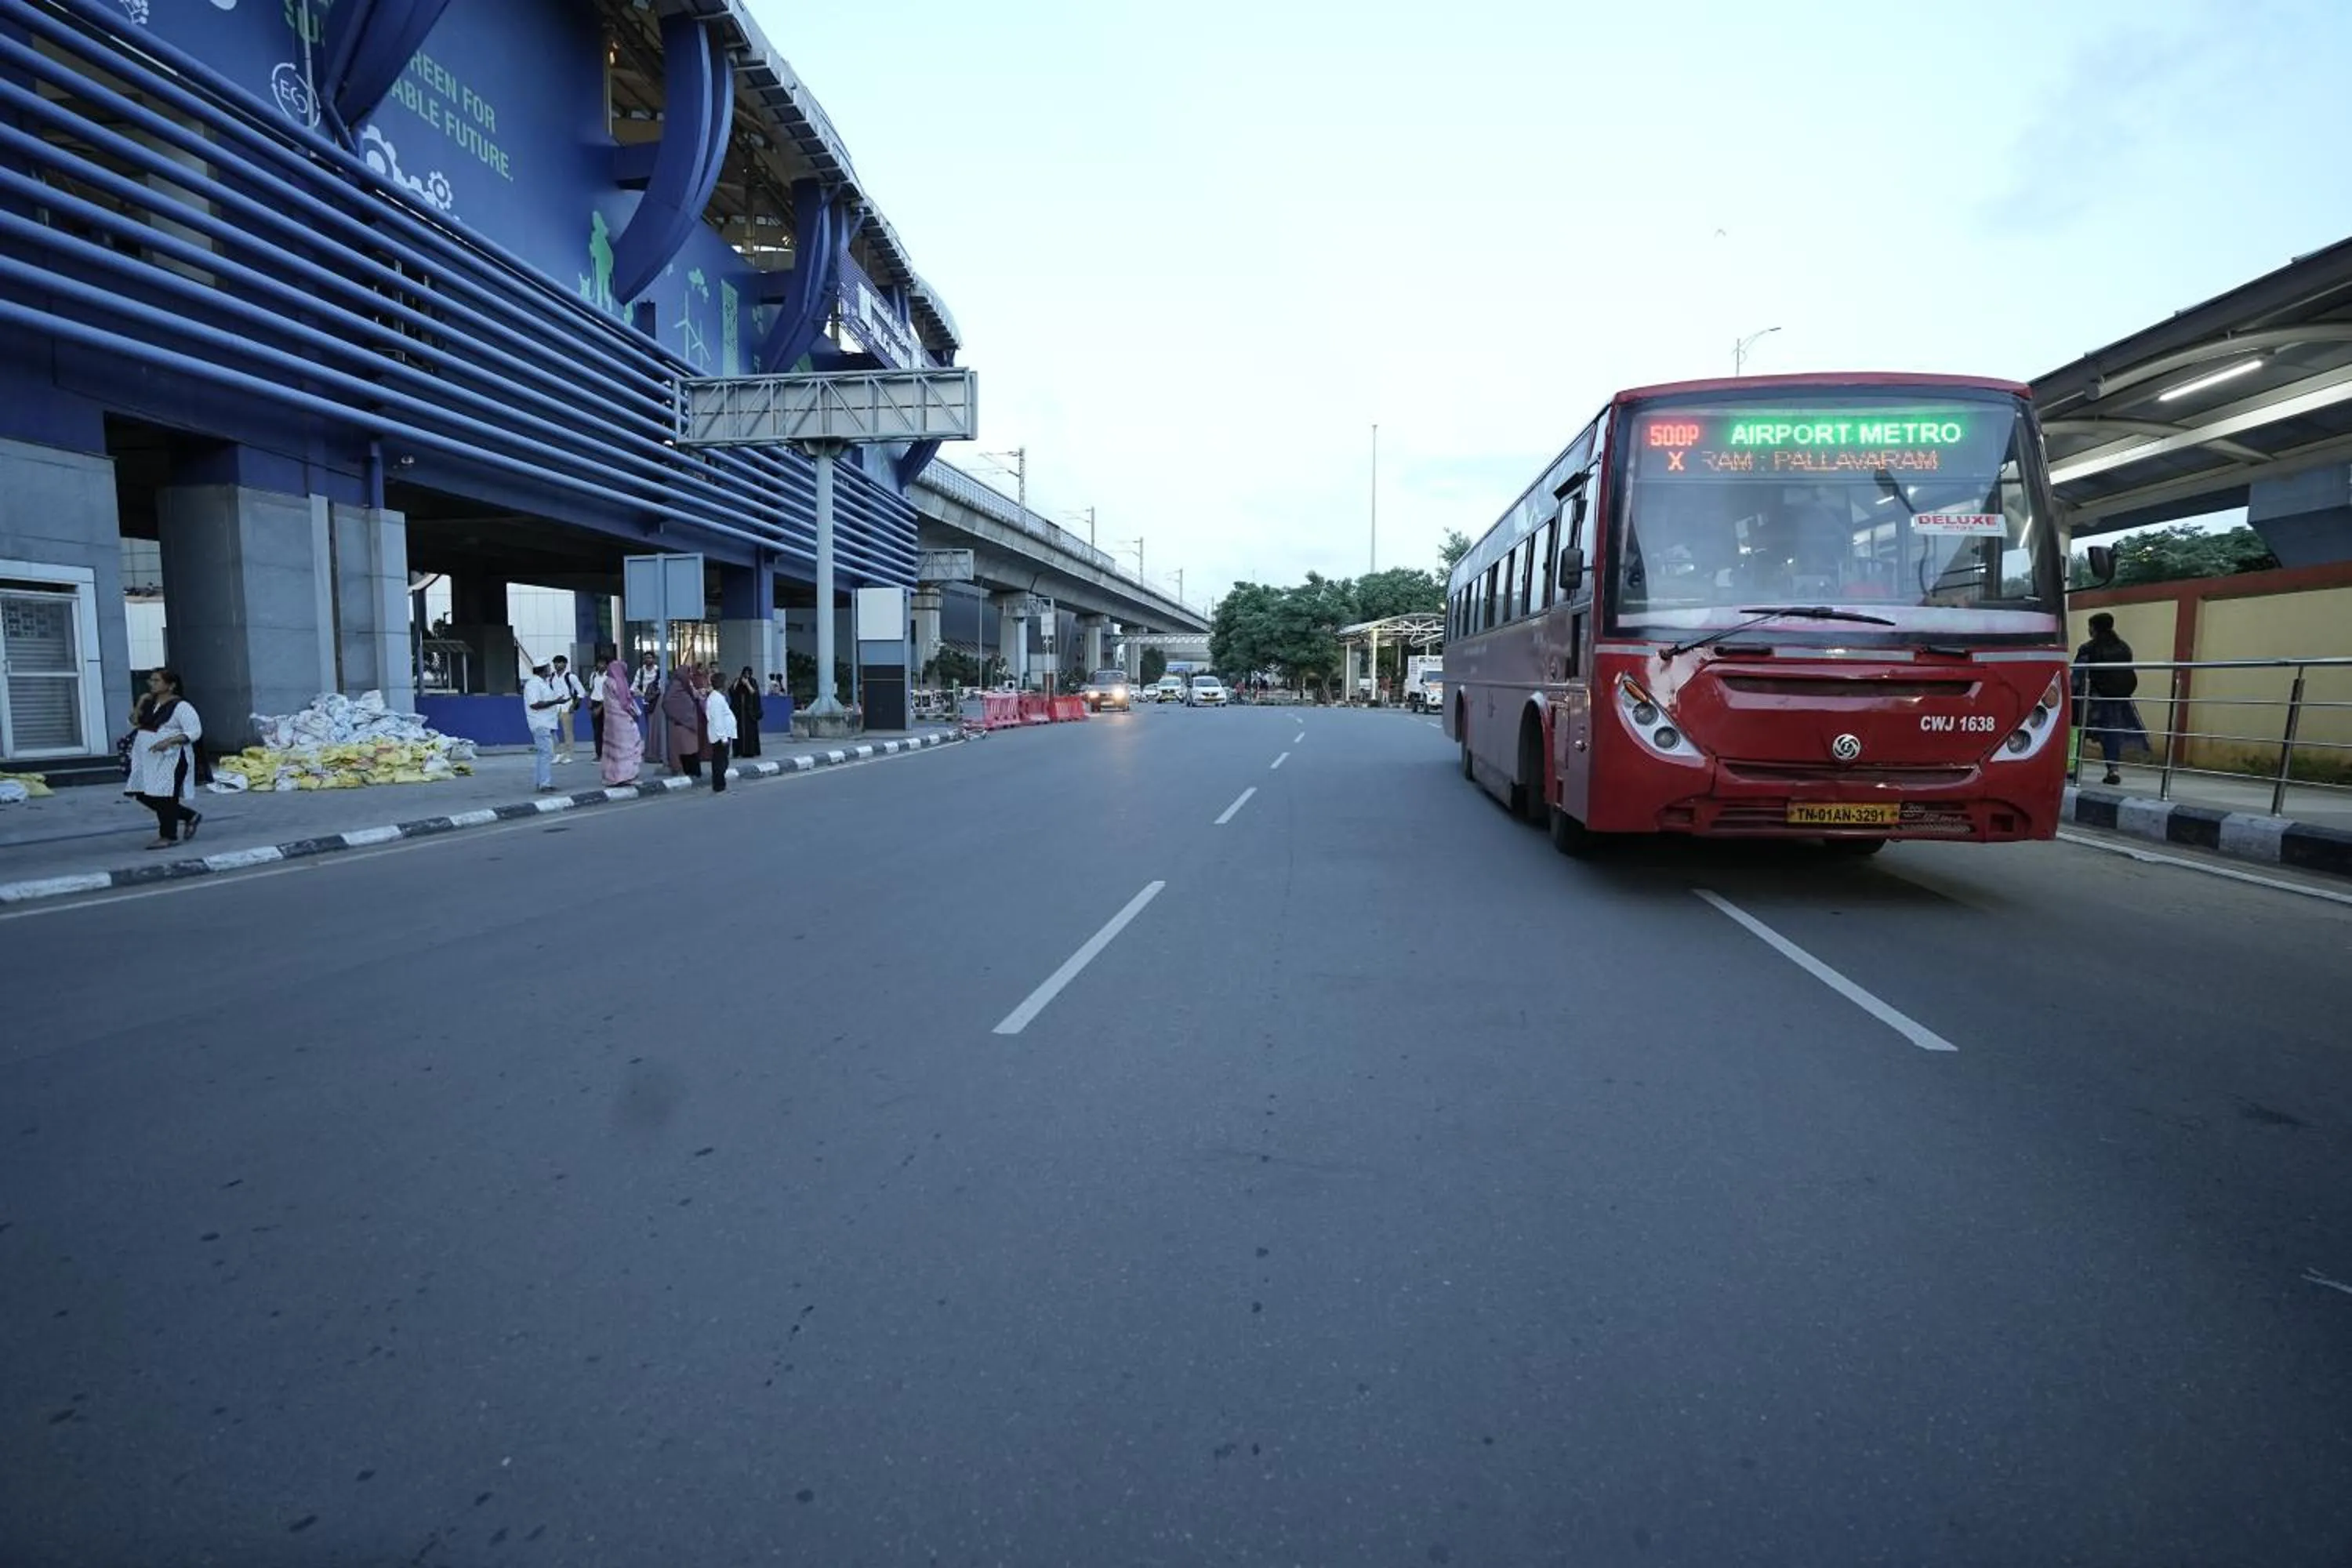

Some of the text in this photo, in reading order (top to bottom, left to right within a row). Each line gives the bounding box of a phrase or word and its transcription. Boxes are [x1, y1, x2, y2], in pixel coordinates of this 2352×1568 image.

[409, 50, 496, 133] REEN FOR
[391, 78, 441, 129] ABLE
[445, 110, 514, 183] FUTURE.
[1650, 422, 1962, 446] 500P AIRPORT METRO
[1668, 451, 1685, 471] X
[1773, 449, 1939, 471] PALLAVARAM
[1918, 514, 1997, 526] DELUXE
[1920, 715, 1995, 731] CWJ 1638
[1797, 808, 1885, 822] TN-01AN-3291
